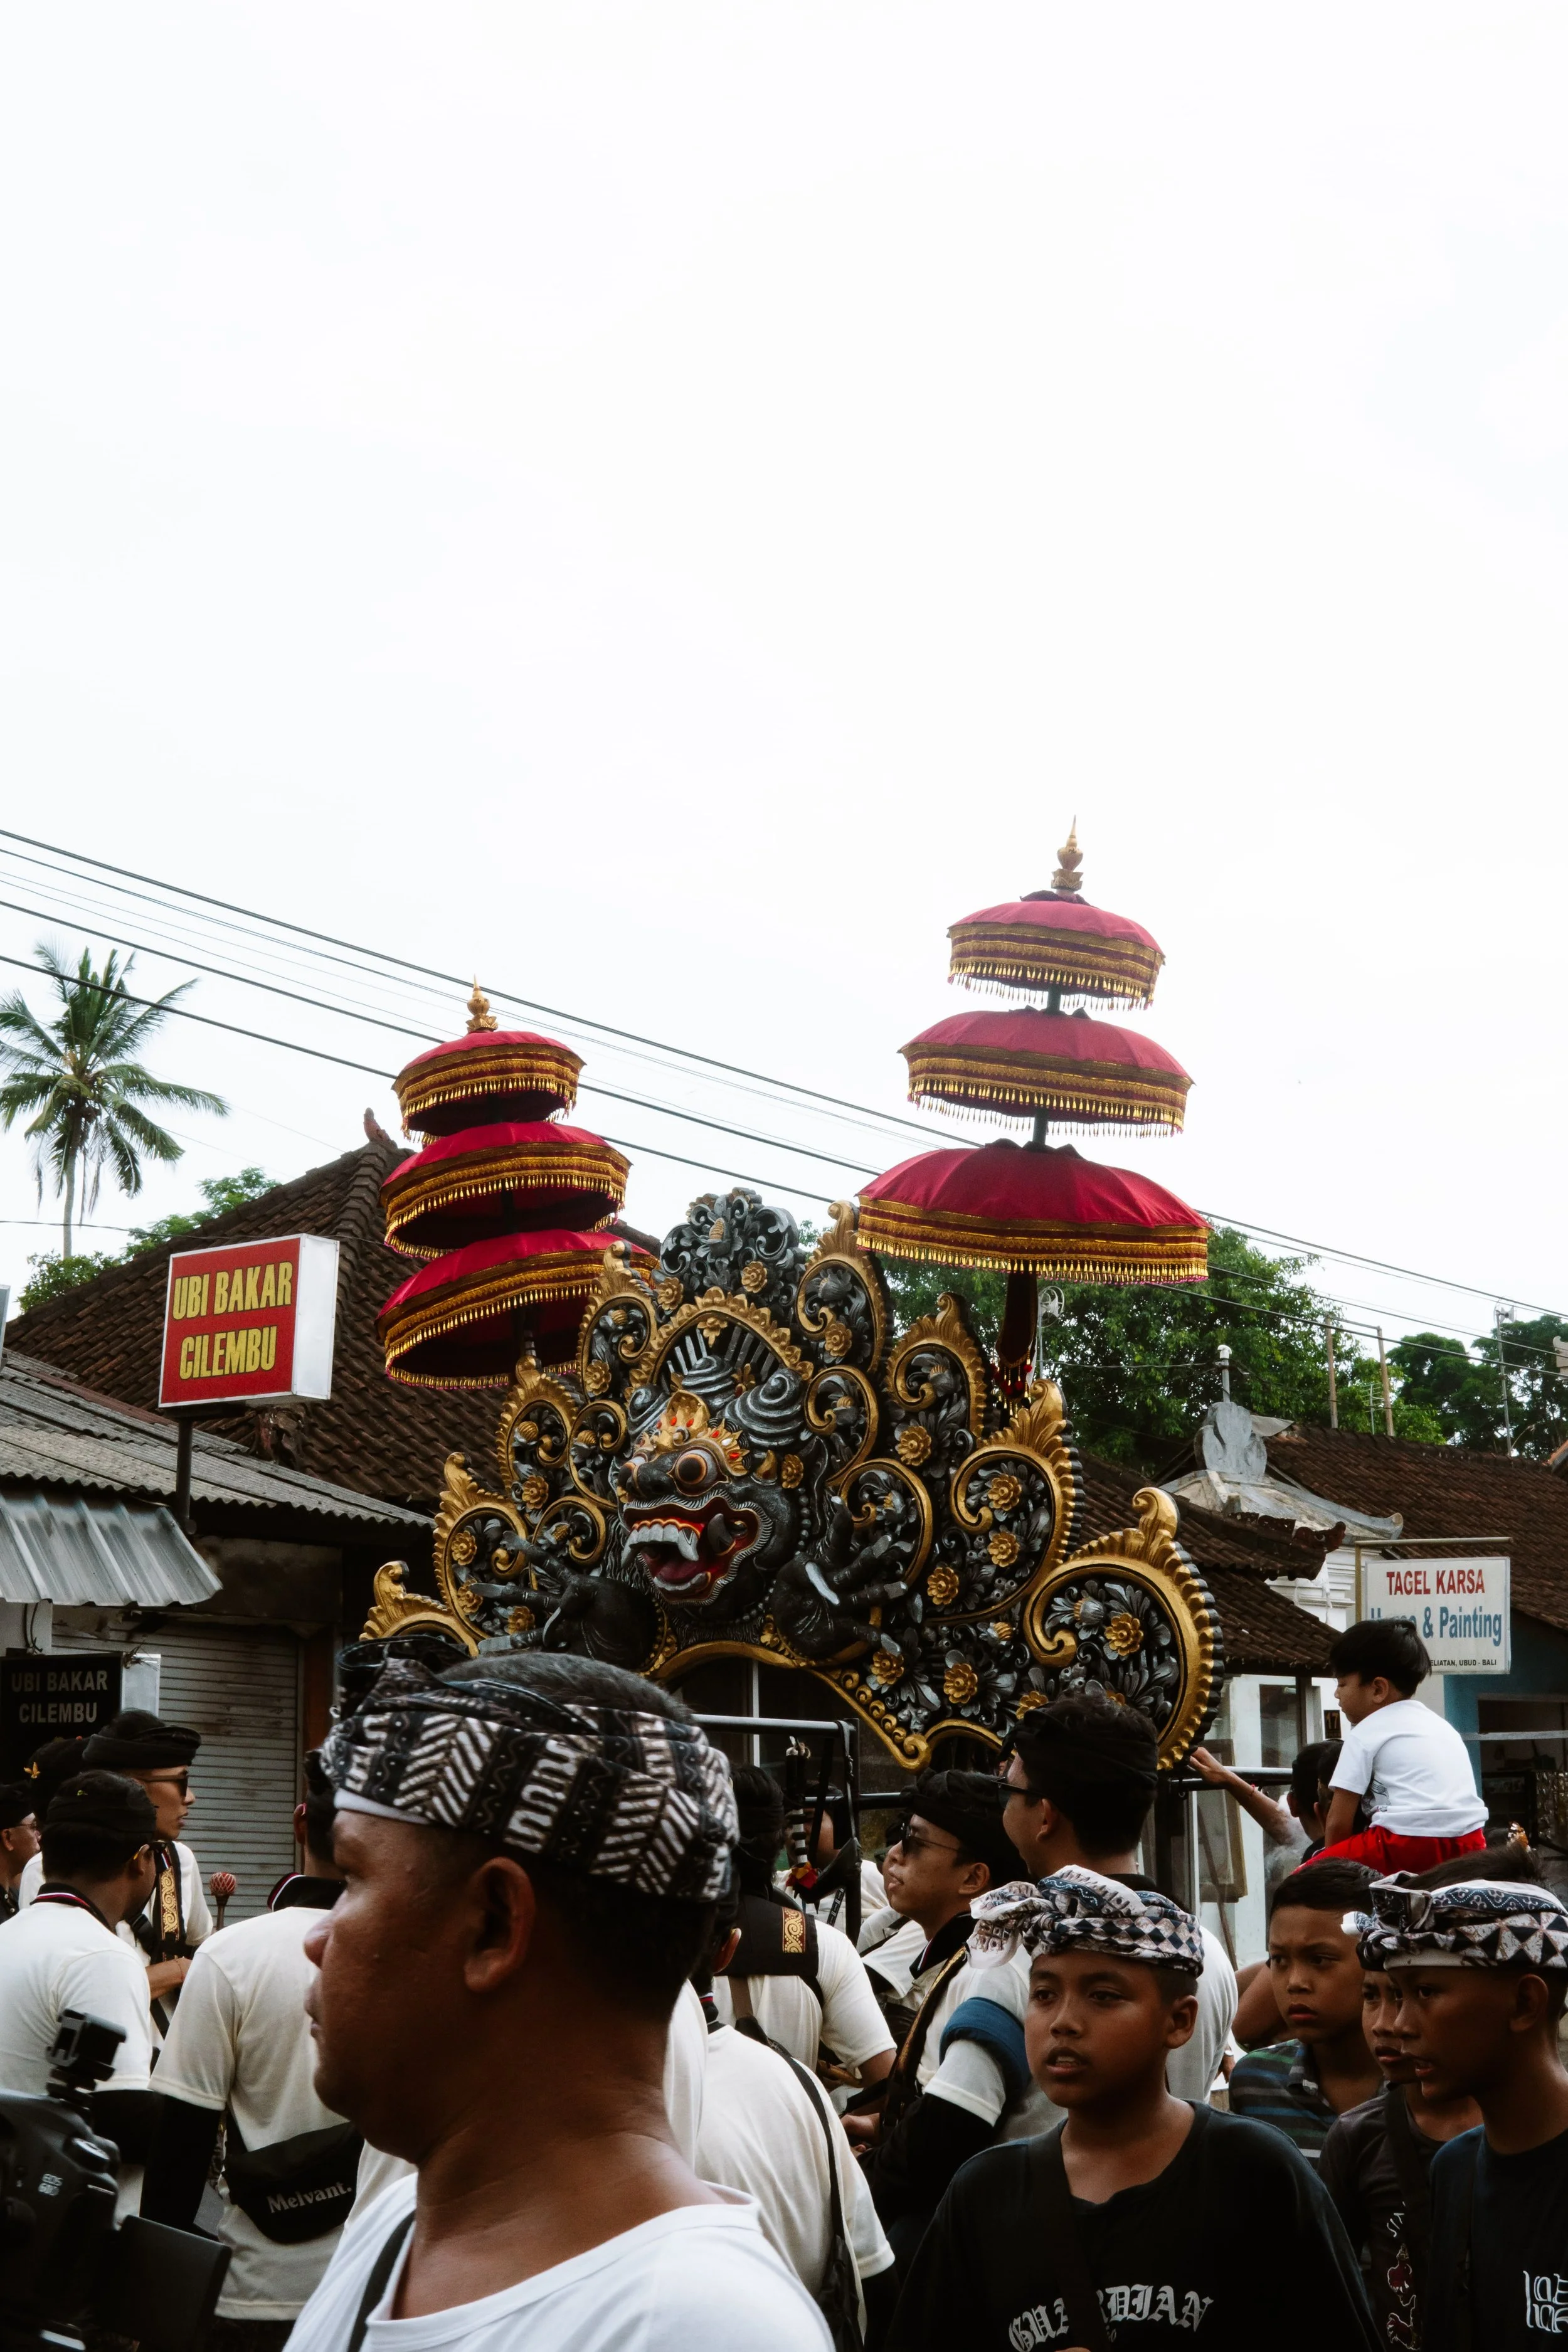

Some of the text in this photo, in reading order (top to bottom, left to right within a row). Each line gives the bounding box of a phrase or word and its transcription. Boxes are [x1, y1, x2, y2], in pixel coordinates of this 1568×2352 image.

[172, 1261, 293, 1320] UBI BAKAR
[179, 1325, 277, 1380] CILEMBU
[1386, 1569, 1485, 1596] TAGEL KARSA
[1422, 1606, 1434, 1639] &
[1439, 1606, 1502, 1647] Painting
[11, 1670, 108, 1693] UBI BAKAR
[19, 1702, 98, 1723] CILEMBU
[42, 2173, 63, 2186] EOS
[266, 2181, 352, 2213] Melvant.
[1009, 2284, 1214, 2352] GUDIAN
